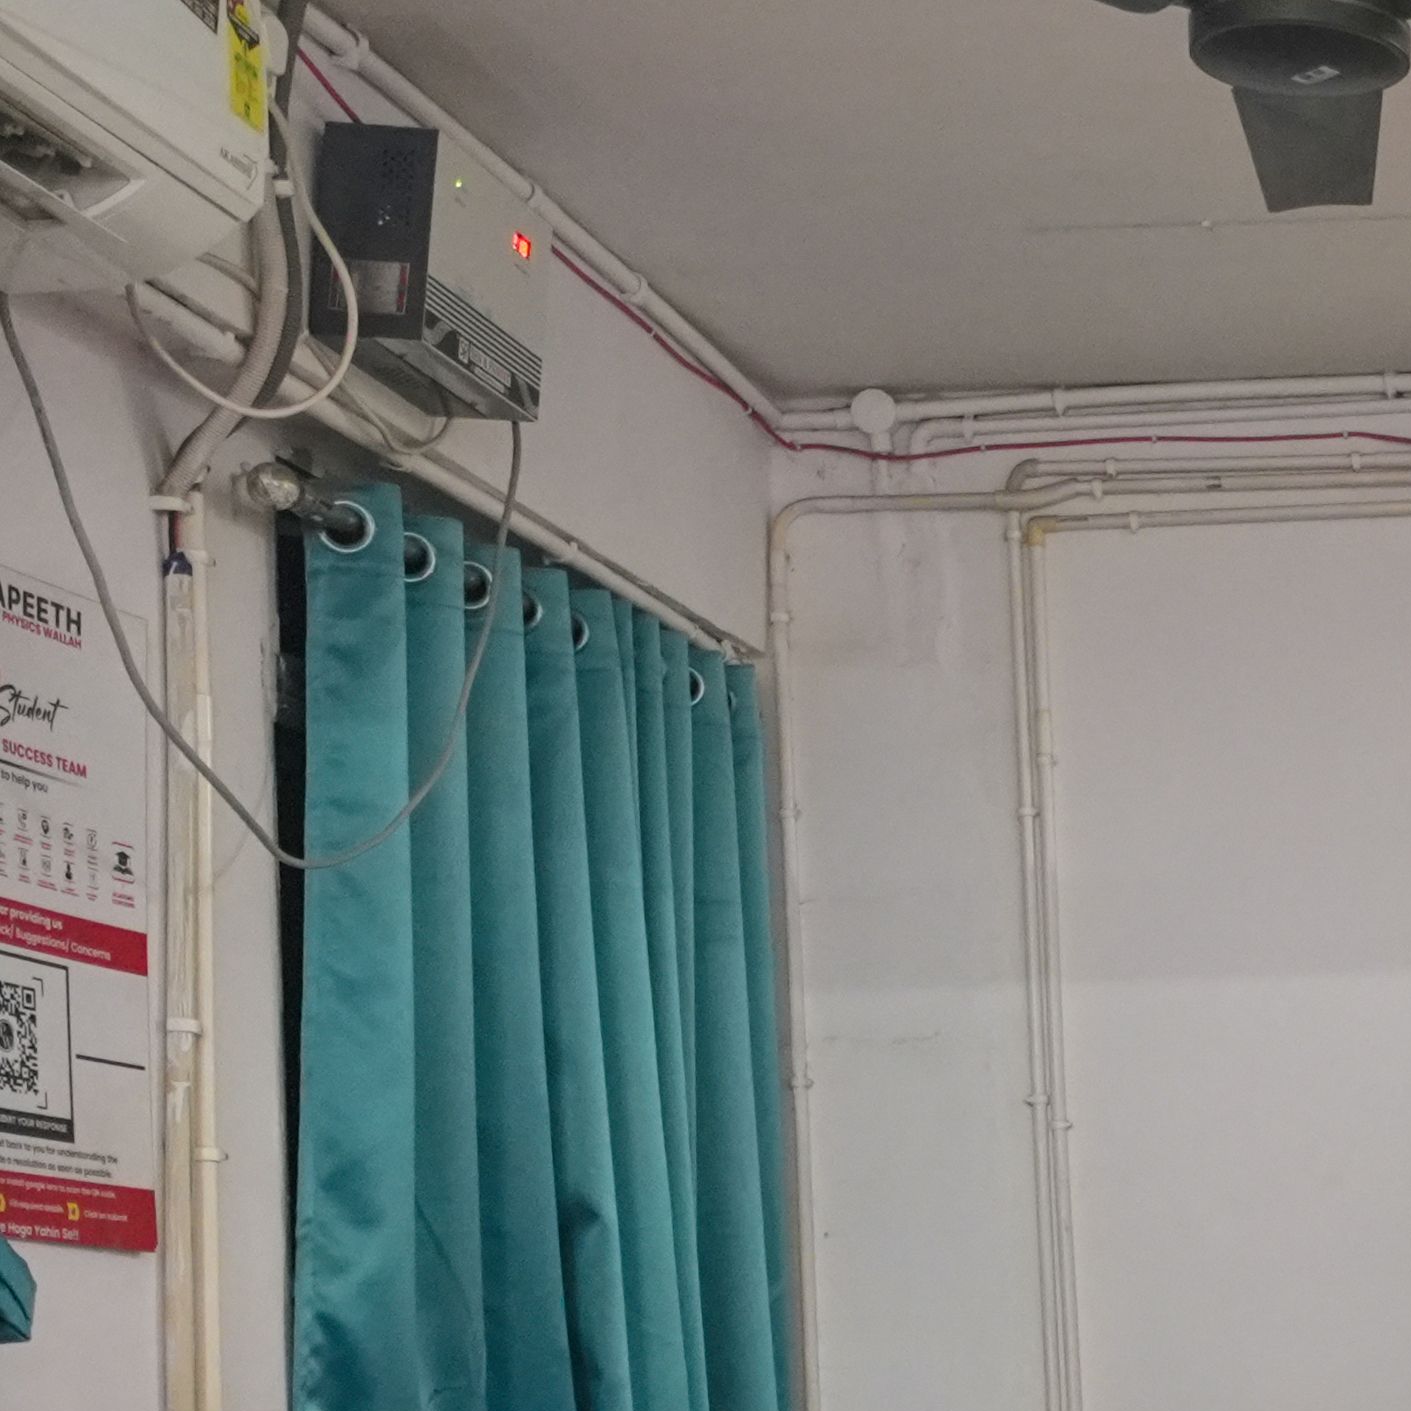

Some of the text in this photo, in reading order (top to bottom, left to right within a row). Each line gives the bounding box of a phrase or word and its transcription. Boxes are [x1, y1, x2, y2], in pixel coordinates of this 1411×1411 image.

[2, 611, 82, 649] PHYSICS WALLAH
[2, 738, 87, 778] SUCCESS TEAM
[12, 772, 30, 790] help
[32, 780, 49, 793] you
[9, 907, 51, 931] providing
[52, 918, 63, 931] us
[8, 1222, 33, 1238] Hoga
